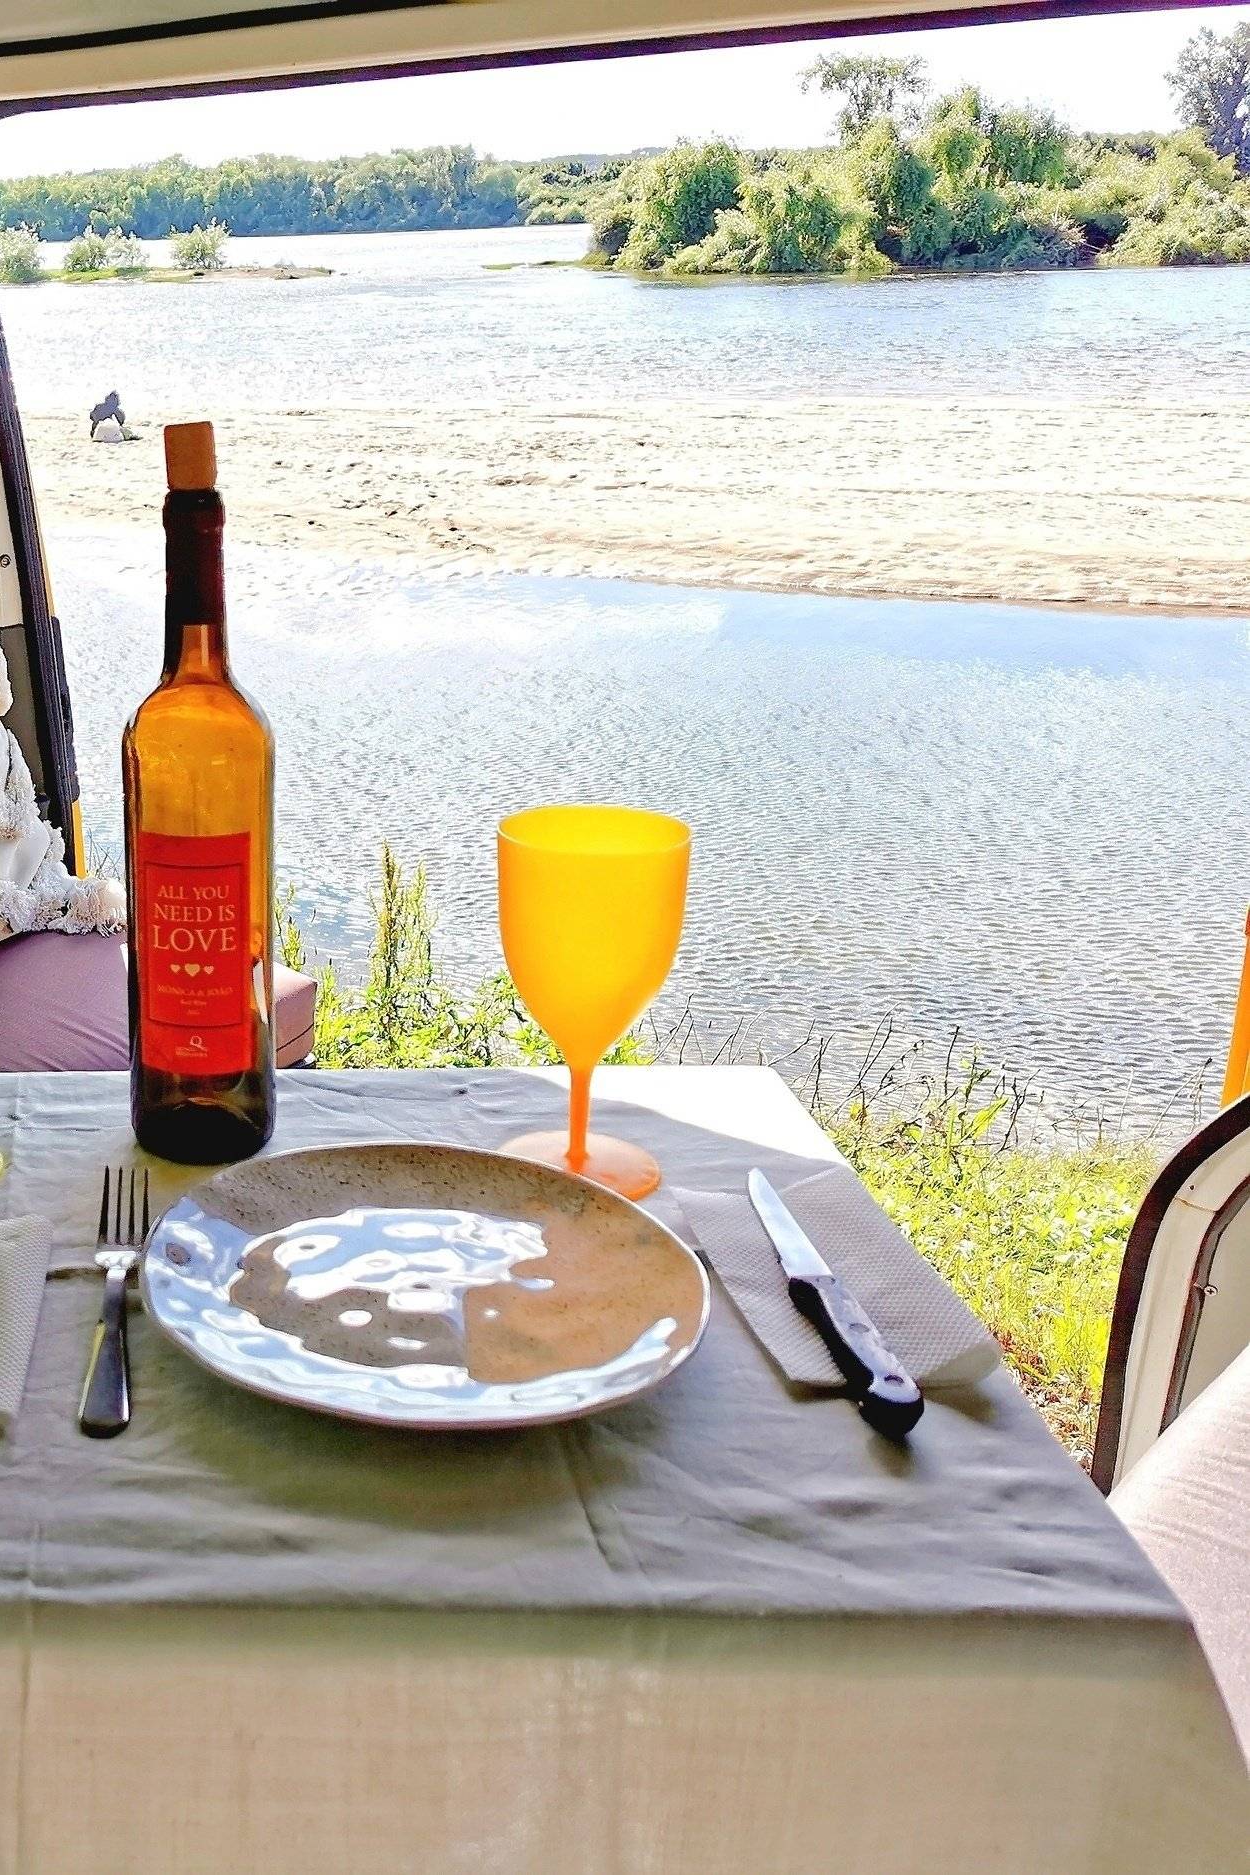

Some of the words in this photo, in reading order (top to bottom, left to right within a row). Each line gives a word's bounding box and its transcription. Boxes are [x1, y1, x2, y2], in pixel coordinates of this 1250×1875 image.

[157, 885, 189, 899] ALL
[192, 885, 230, 900] YOU
[153, 902, 212, 922] NEED
[218, 904, 235, 922] IS
[152, 924, 236, 952] LOVE
